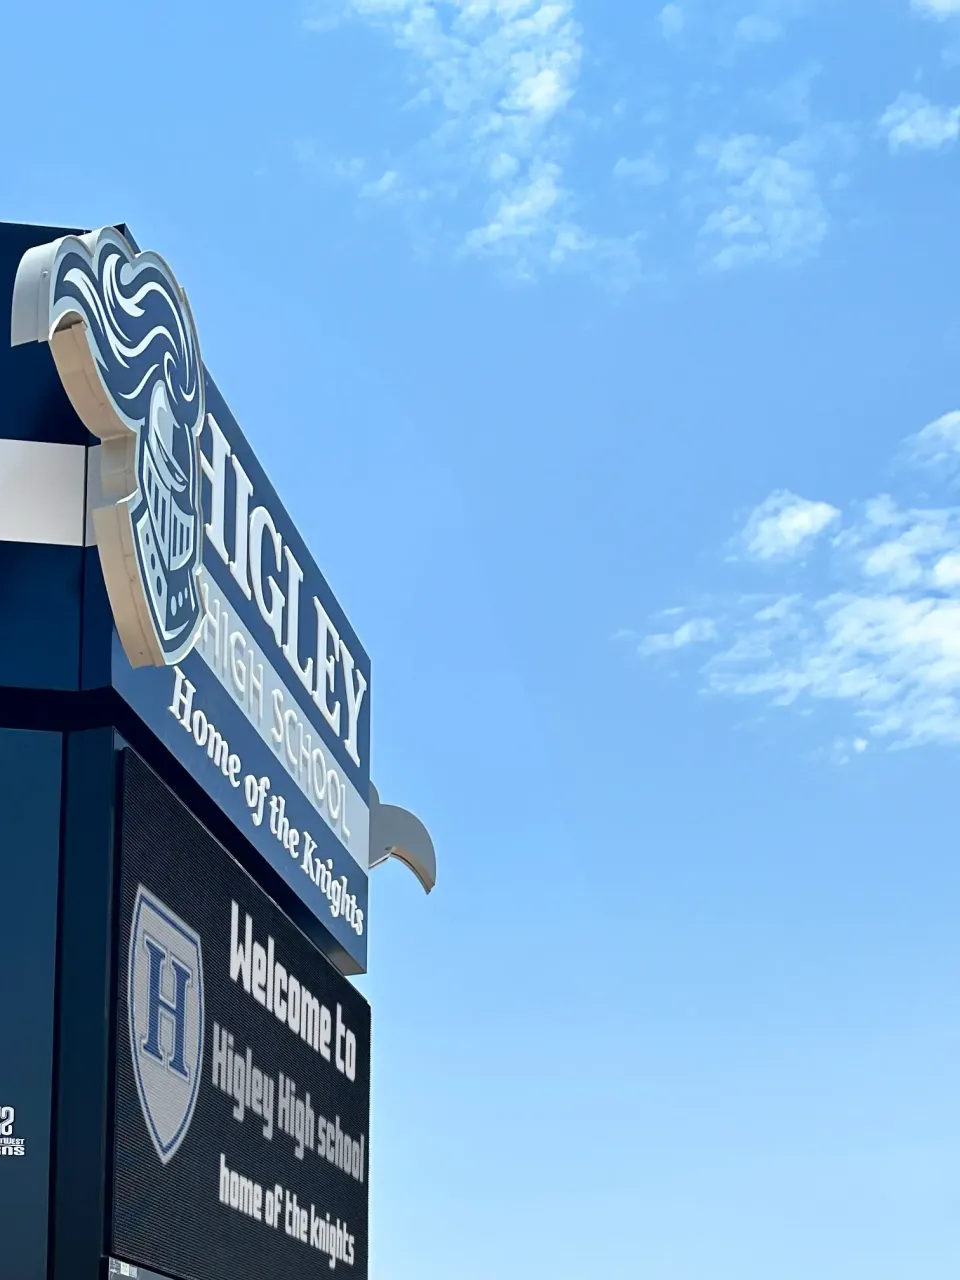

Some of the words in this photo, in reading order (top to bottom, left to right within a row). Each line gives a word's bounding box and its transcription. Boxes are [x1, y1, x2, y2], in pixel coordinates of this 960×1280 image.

[200, 412, 367, 768] HIGLEY
[168, 666, 241, 789] Home
[244, 770, 269, 826] of
[268, 796, 300, 858] the
[300, 831, 364, 936] Knights
[201, 582, 264, 725] HIGH
[271, 688, 352, 841] SCHOOL
[142, 938, 194, 1086] H
[230, 900, 332, 1056] Welcome
[335, 1003, 357, 1082] to
[212, 1023, 275, 1139] Higley
[278, 1072, 315, 1160] High
[317, 1110, 365, 1184] school
[219, 1153, 262, 1223] home
[265, 1184, 284, 1227] of
[285, 1189, 308, 1244] the
[310, 1206, 356, 1269] knights
